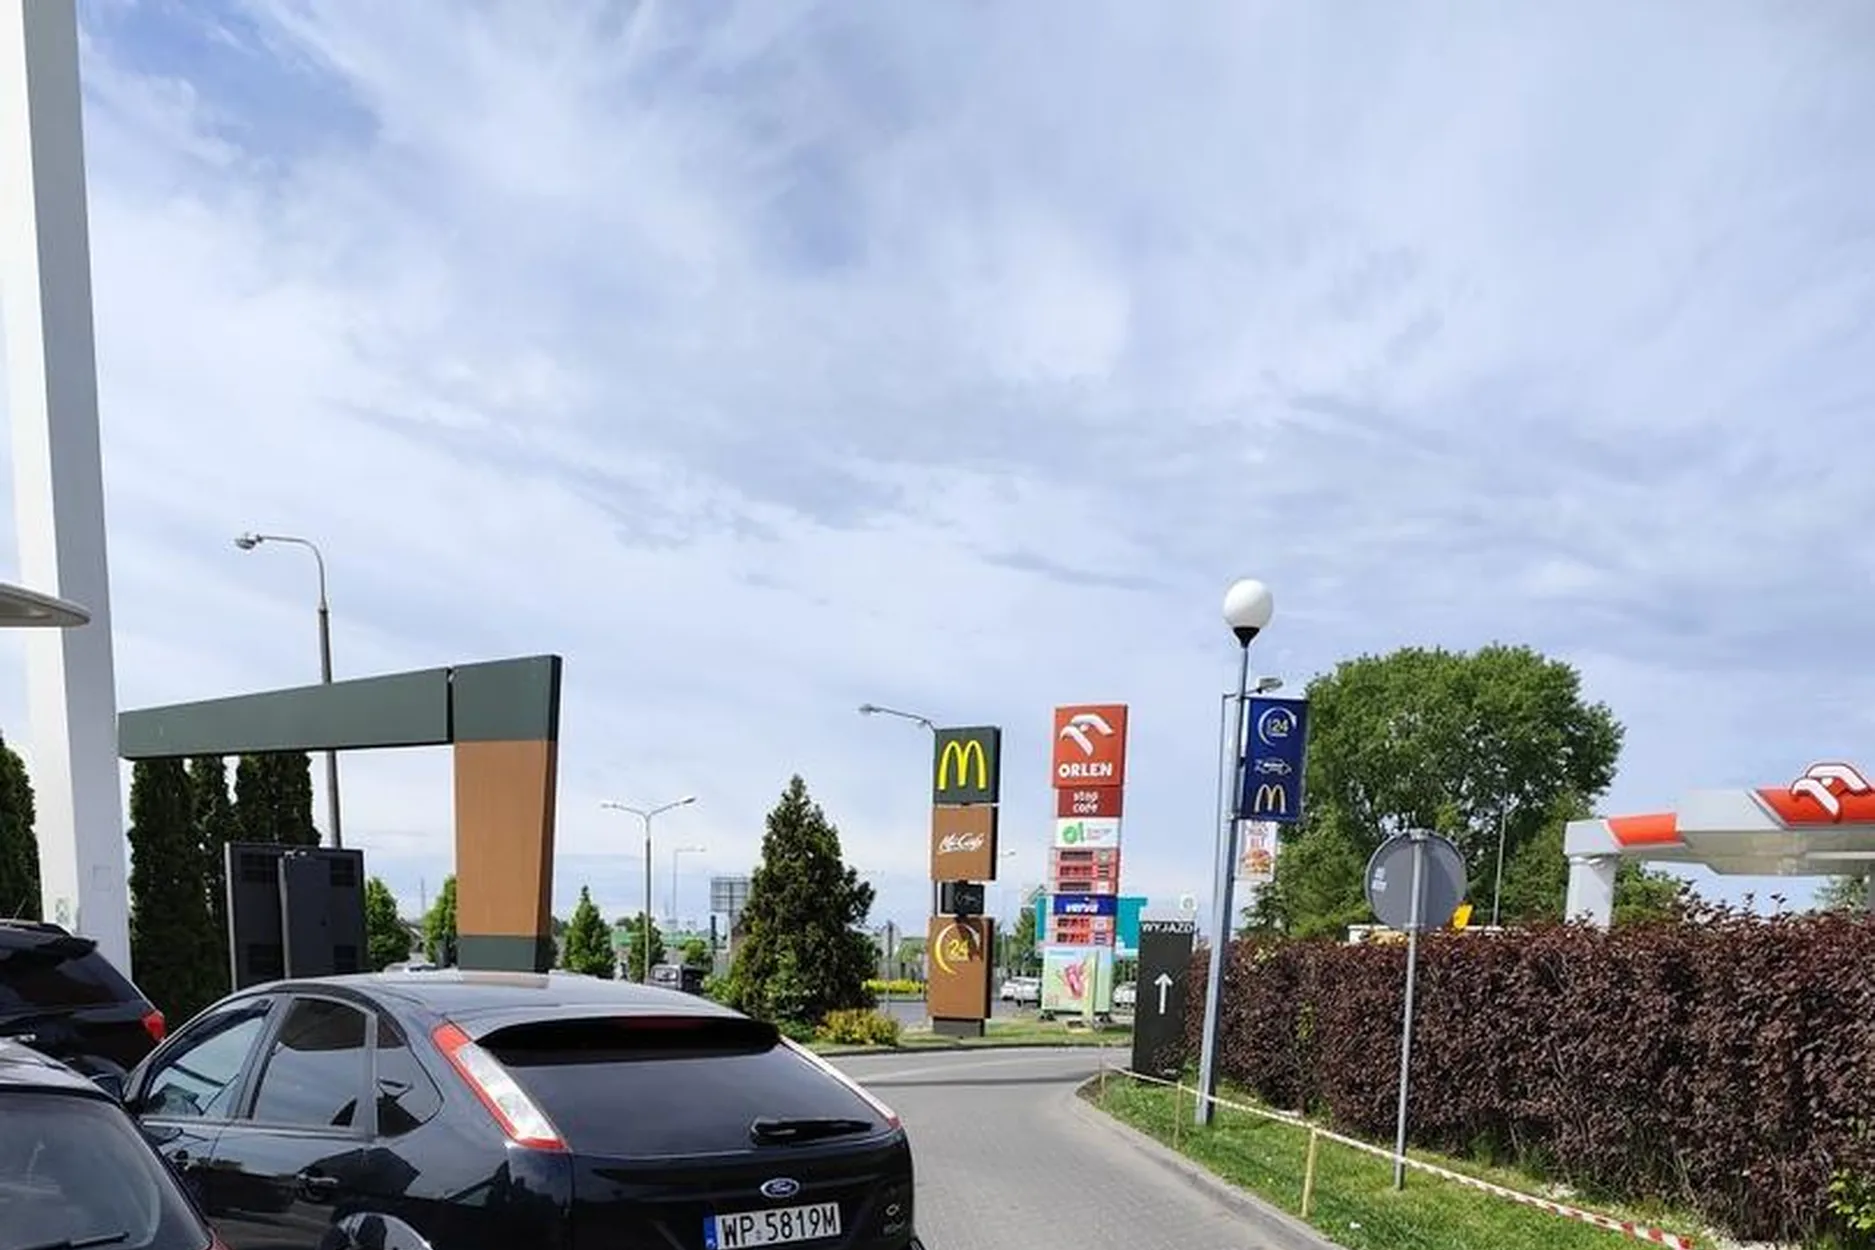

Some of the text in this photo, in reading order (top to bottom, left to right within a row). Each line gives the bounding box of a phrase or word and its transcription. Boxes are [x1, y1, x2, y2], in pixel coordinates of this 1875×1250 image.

[1059, 762, 1113, 777] ORLEN
[1142, 923, 1193, 934] WYJAZD
[950, 939, 969, 956] 24
[721, 1205, 837, 1247] WP 5819M
